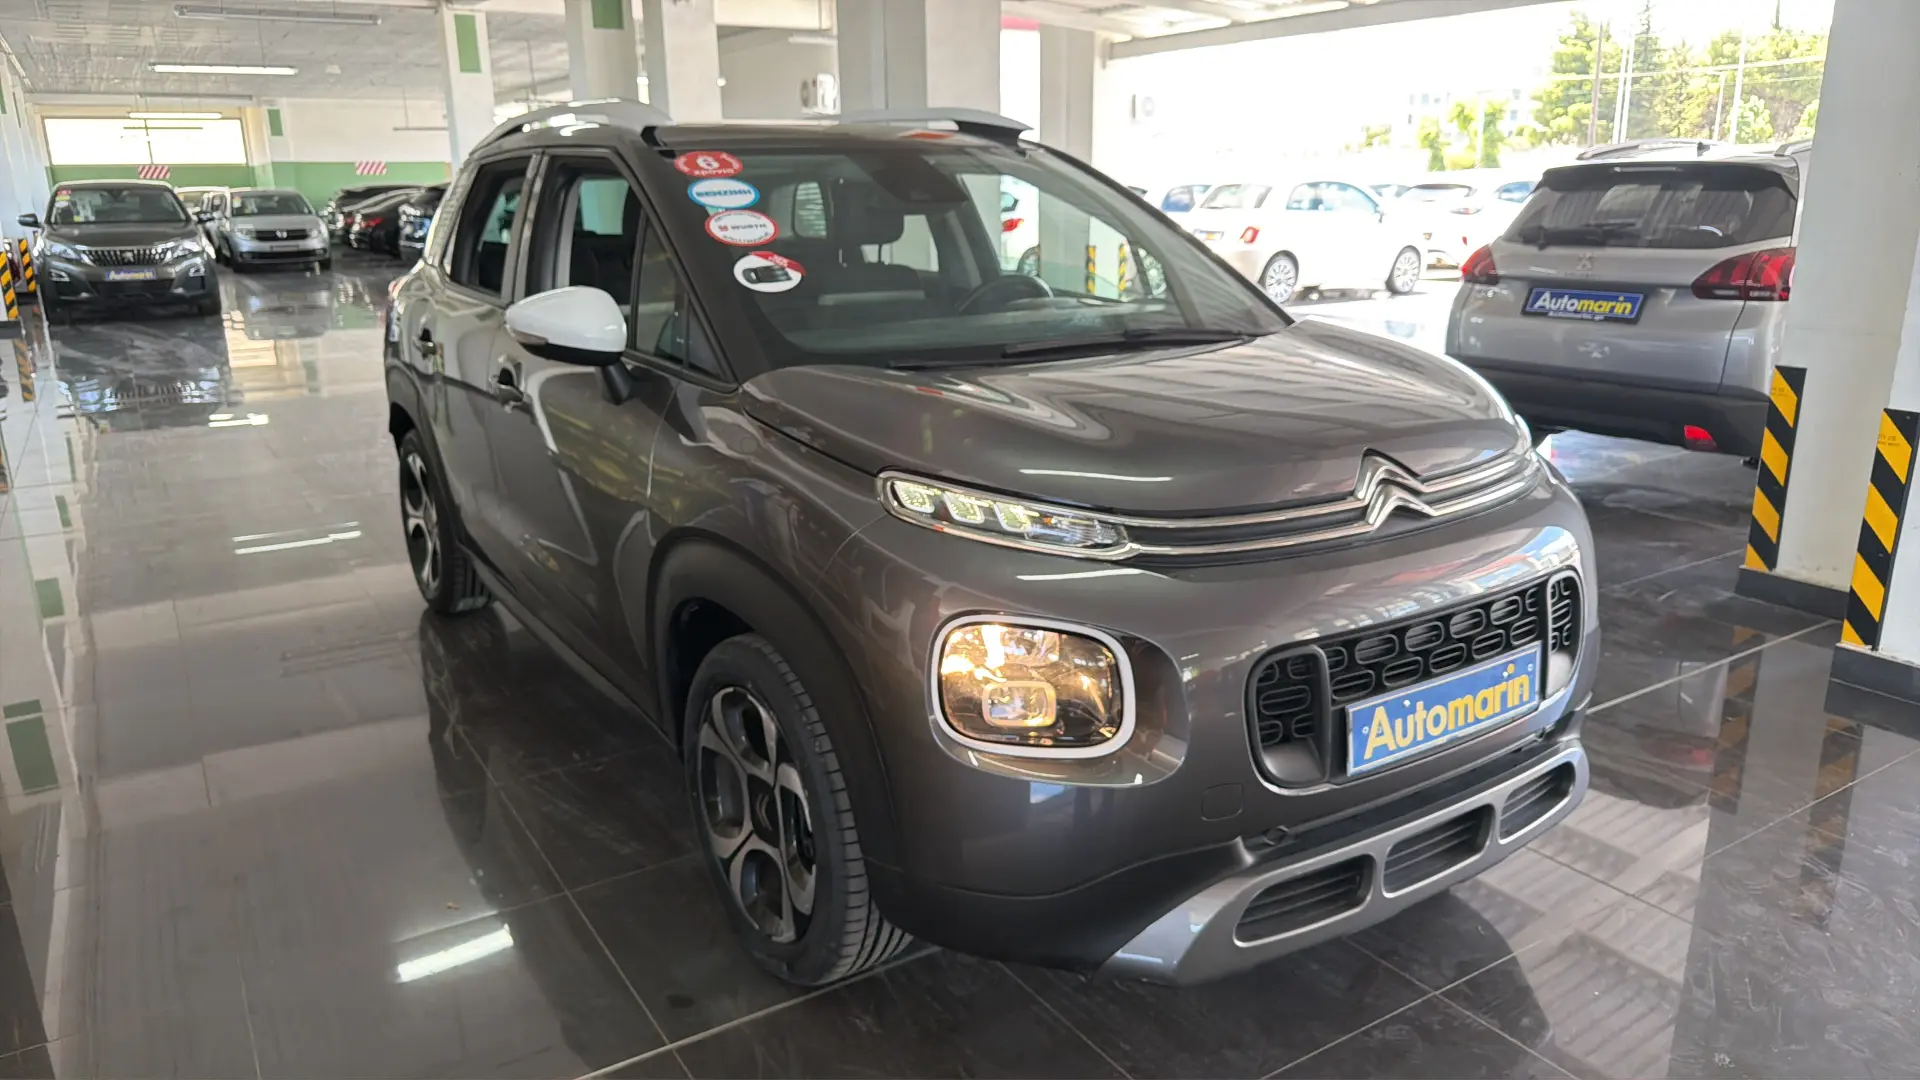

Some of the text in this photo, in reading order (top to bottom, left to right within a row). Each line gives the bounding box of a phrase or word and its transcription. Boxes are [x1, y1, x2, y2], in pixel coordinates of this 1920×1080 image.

[696, 155, 720, 170] 6
[1533, 290, 1632, 315] Automarin
[1363, 663, 1530, 760] Automarin
